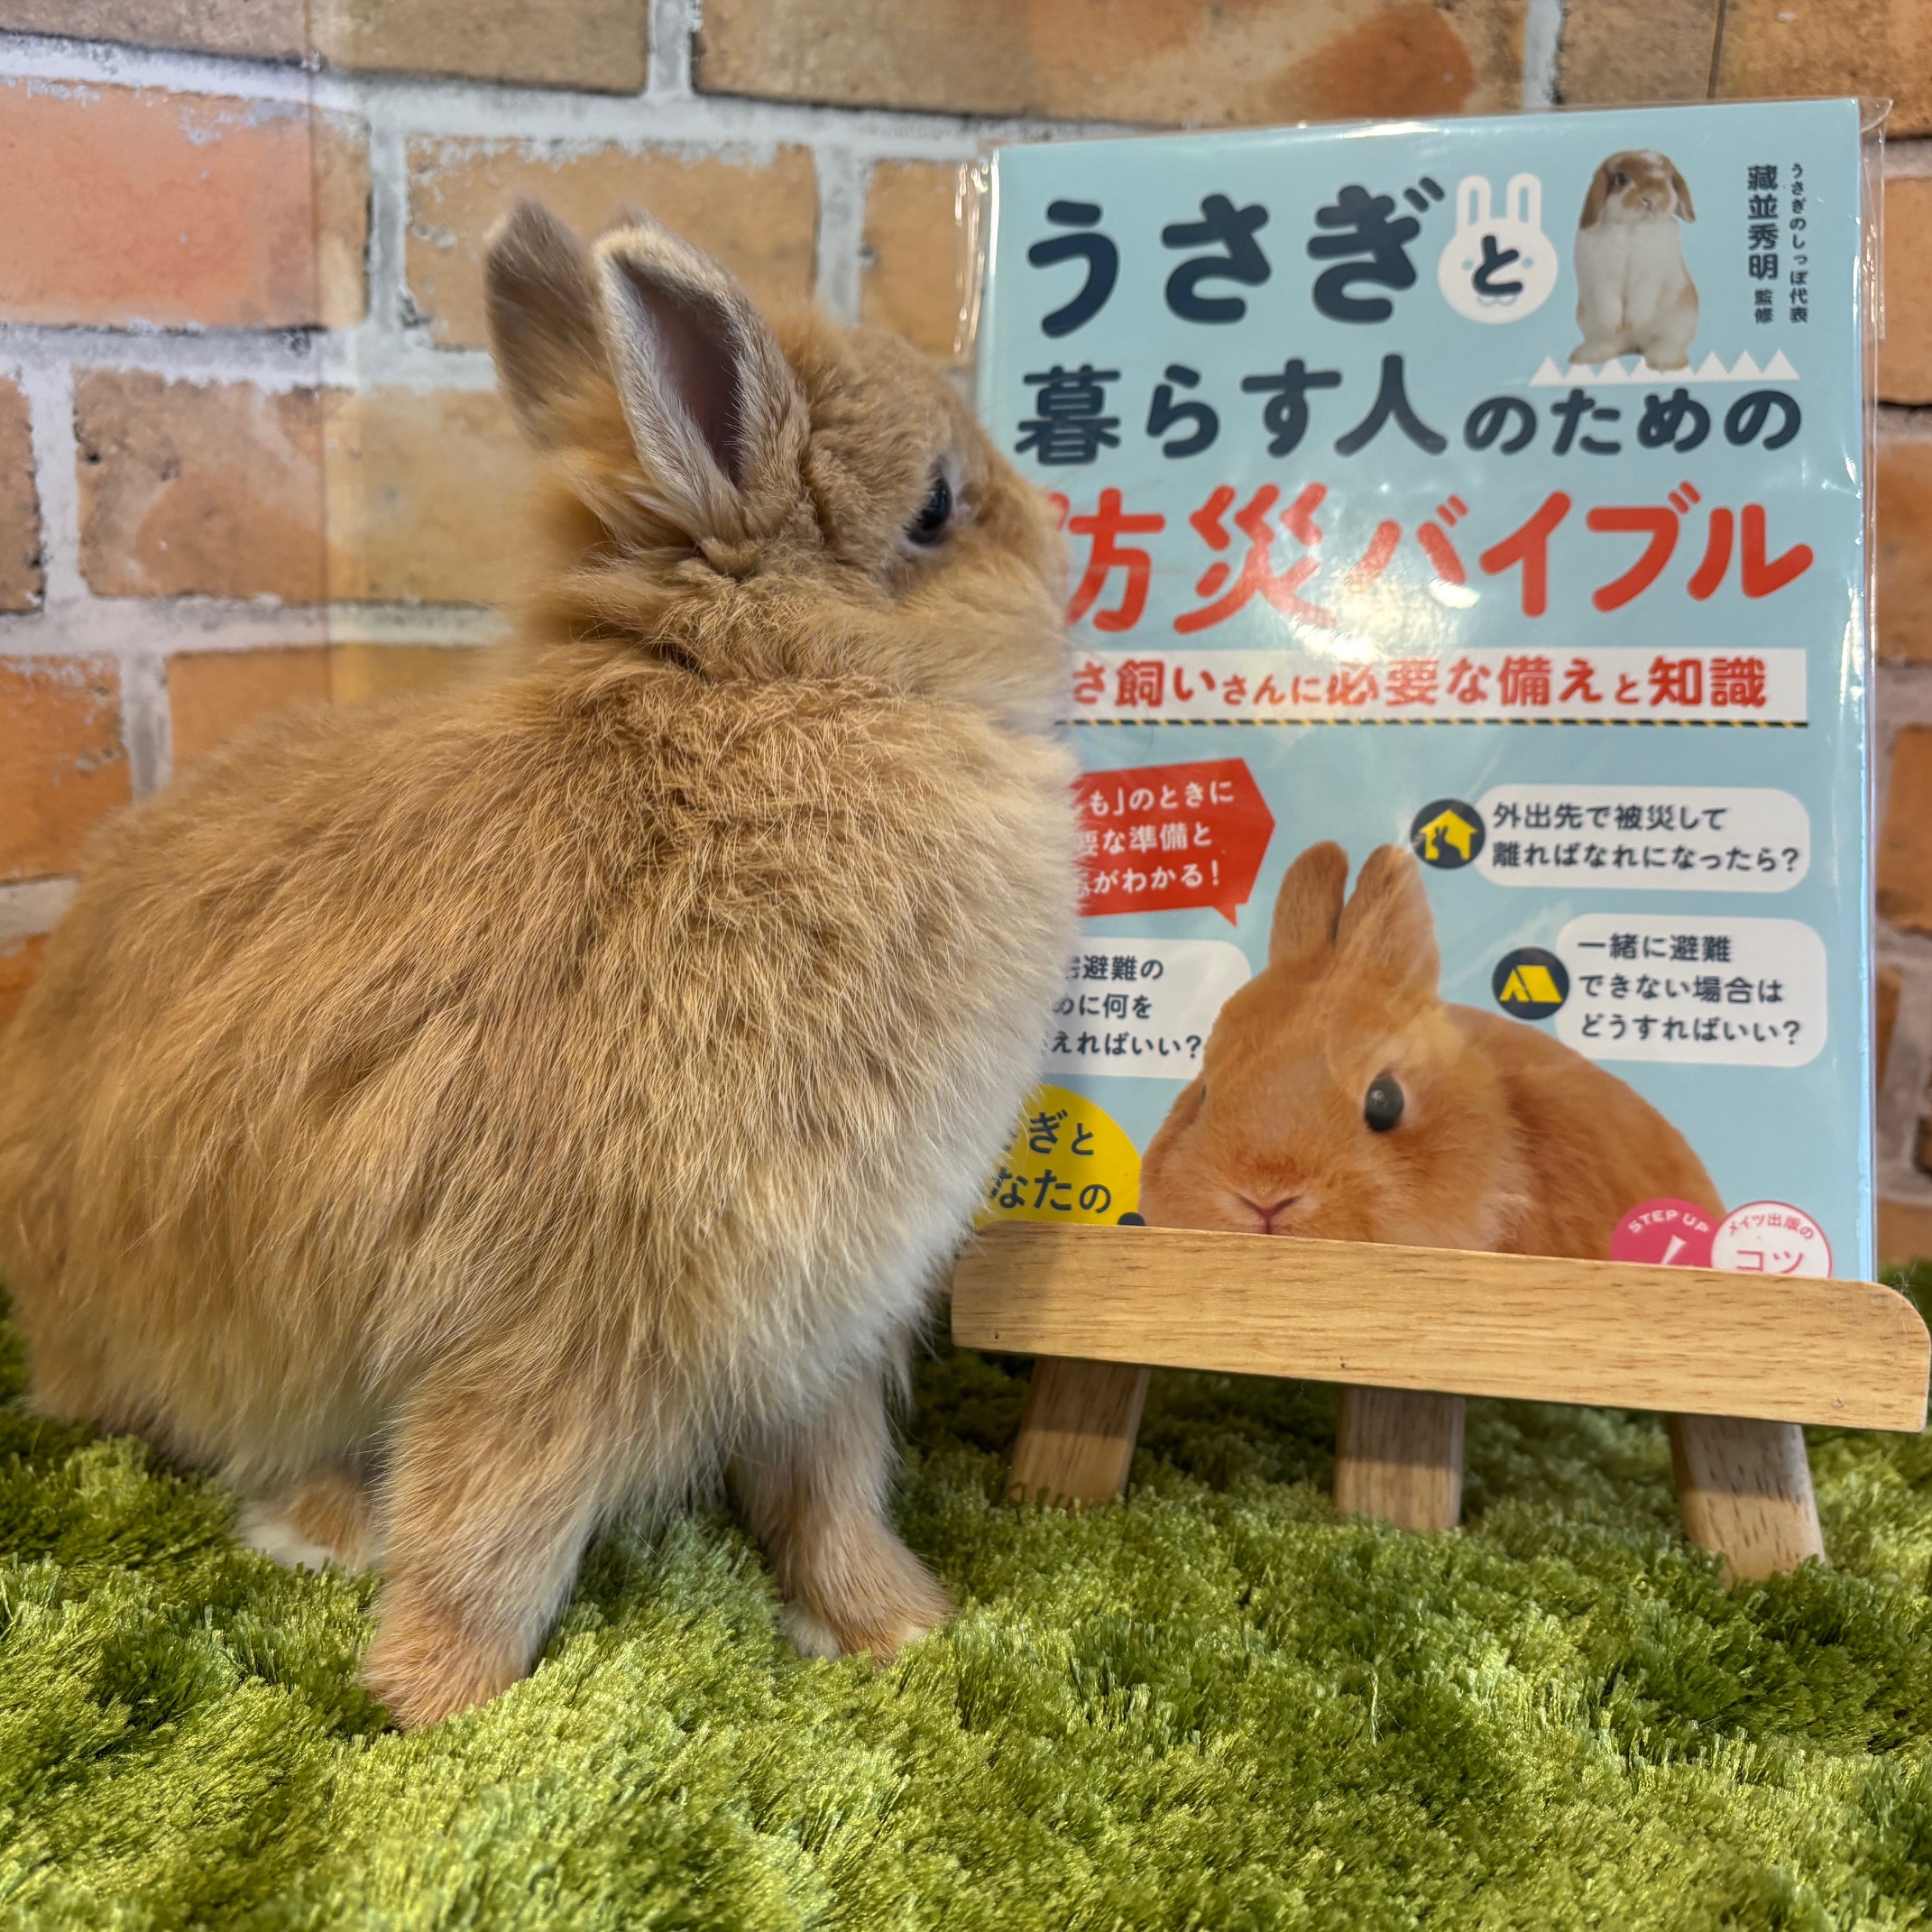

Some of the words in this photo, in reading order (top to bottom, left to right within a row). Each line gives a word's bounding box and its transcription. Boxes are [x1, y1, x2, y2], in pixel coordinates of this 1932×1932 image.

[1789, 162, 1809, 323] うさぎのしっぽ代表
[1754, 289, 1774, 325] 監修
[1015, 353, 1802, 465] 暮らす人のための
[1493, 802, 1728, 832] 外出先で被災して
[1492, 841, 1800, 872] 離ればなれになったら？
[1578, 933, 1732, 962] 一緒に避難
[1578, 974, 1784, 1004] できない場合は
[1579, 1013, 1801, 1044] どうすればいい？
[1042, 1030, 1202, 1059] えればいい？
[1001, 1109, 1094, 1155] ぎと
[1628, 1209, 1679, 1234] STEP
[1682, 1212, 1710, 1233] UP
[1728, 1213, 1815, 1240] メイツ出版の
